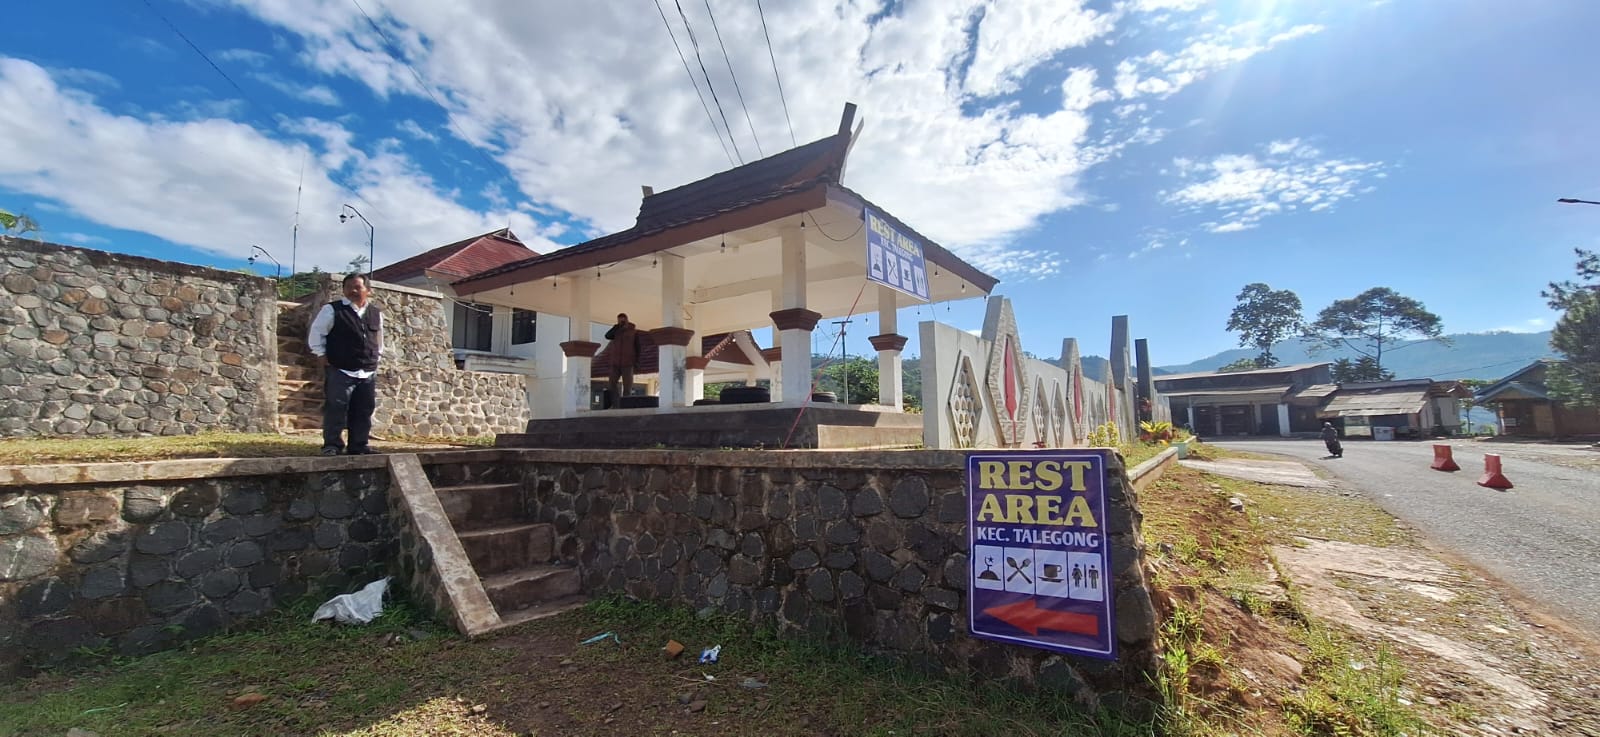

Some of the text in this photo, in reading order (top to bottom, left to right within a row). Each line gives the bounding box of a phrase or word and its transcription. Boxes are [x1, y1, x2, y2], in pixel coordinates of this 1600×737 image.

[868, 214, 921, 257] REST AREA
[978, 461, 1092, 491] REST
[977, 494, 1098, 527] AREA
[977, 527, 1099, 547] KEC. TALEGONG
